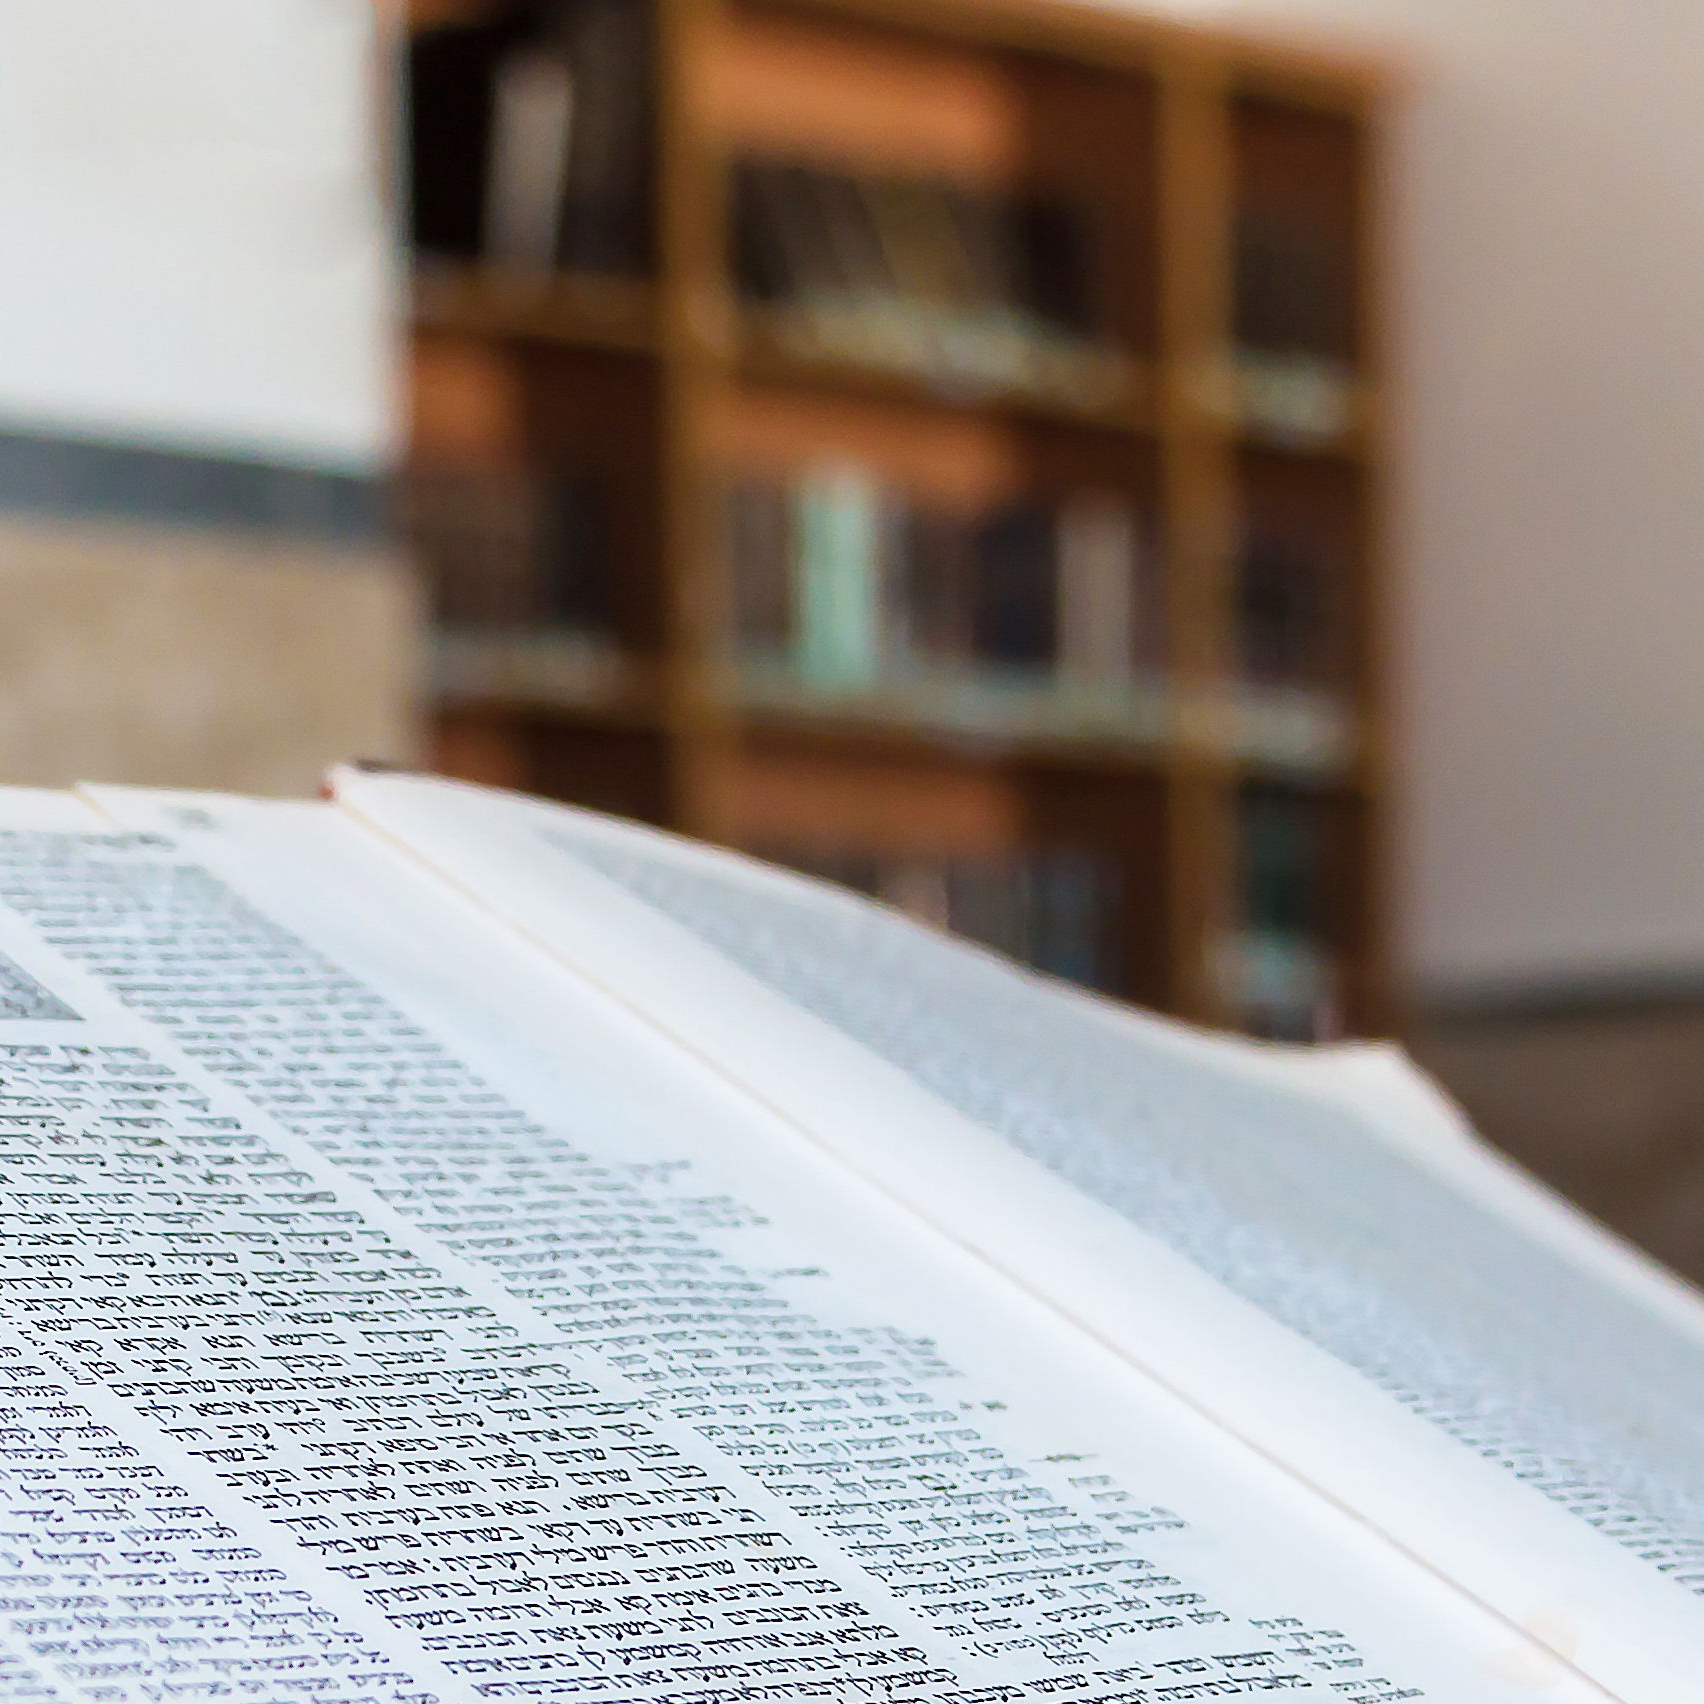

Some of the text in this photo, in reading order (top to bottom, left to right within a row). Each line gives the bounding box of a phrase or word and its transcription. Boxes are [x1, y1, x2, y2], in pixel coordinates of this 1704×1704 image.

[65, 1207, 145, 1225] חלבים
[3, 1253, 85, 1268] השחר
[94, 1252, 157, 1269] עמוד
[161, 1247, 239, 1267] שיעלה
[249, 1250, 286, 1265] עד
[144, 1272, 213, 1287] חצות
[210, 1271, 248, 1288] עד
[250, 1269, 329, 1285] חכמים
[54, 1339, 104, 1358] קאי
[113, 1336, 187, 1356] אקרא
[201, 1334, 256, 1349] תנא
[262, 1332, 347, 1347] ברישא
[79, 1360, 125, 1380] זמן
[130, 1358, 193, 1377] קתני
[199, 1356, 260, 1371] והכי
[259, 1353, 351, 1374] ובקומך
[133, 1385, 528, 1424] לאכול בתרומתן ואי בעית אימא יליף
[300, 1422, 654, 1461] בקר יום אחד אי הכי סיפא דקתני
[215, 1443, 681, 1488] מברך שתים לפניה ואחת לאחריה ובערב
[242, 1465, 708, 1510] מברך שתים לפניה ושתים לאחריה לתני
[269, 1485, 737, 1533] דערבית ברישא. תנא פתח בערבית והדר
[296, 1507, 766, 1556] תני בשחרית עד דקאי בשחרית פריש מילי
[581, 1543, 649, 1561] פריש
[642, 1538, 707, 1556] והדר
[698, 1532, 793, 1552] דשחרית
[529, 1545, 588, 1565] מילי
[743, 1555, 819, 1575] משעה
[325, 1564, 370, 1580] מר
[362, 1558, 426, 1576] אמר
[632, 1559, 736, 1583] שהכהנים
[469, 1571, 549, 1596] לאכול
[547, 1570, 632, 1590] נכנסים
[384, 1579, 843, 1631] מכדי כהנים אימת קא אכלי תרומה משעת
[815, 1601, 870, 1620] צאת
[658, 1610, 715, 1633] לתני
[721, 1606, 821, 1626] הכוכבים
[529, 1625, 587, 1644] צאת
[582, 1620, 664, 1642] משעת
[440, 1620, 900, 1675] מלתא אגב אורחיה קמשמע לן כהנים אימת
[1152, 1657, 1207, 1675] וטהר
[1022, 1673, 1090, 1694] שמשו
